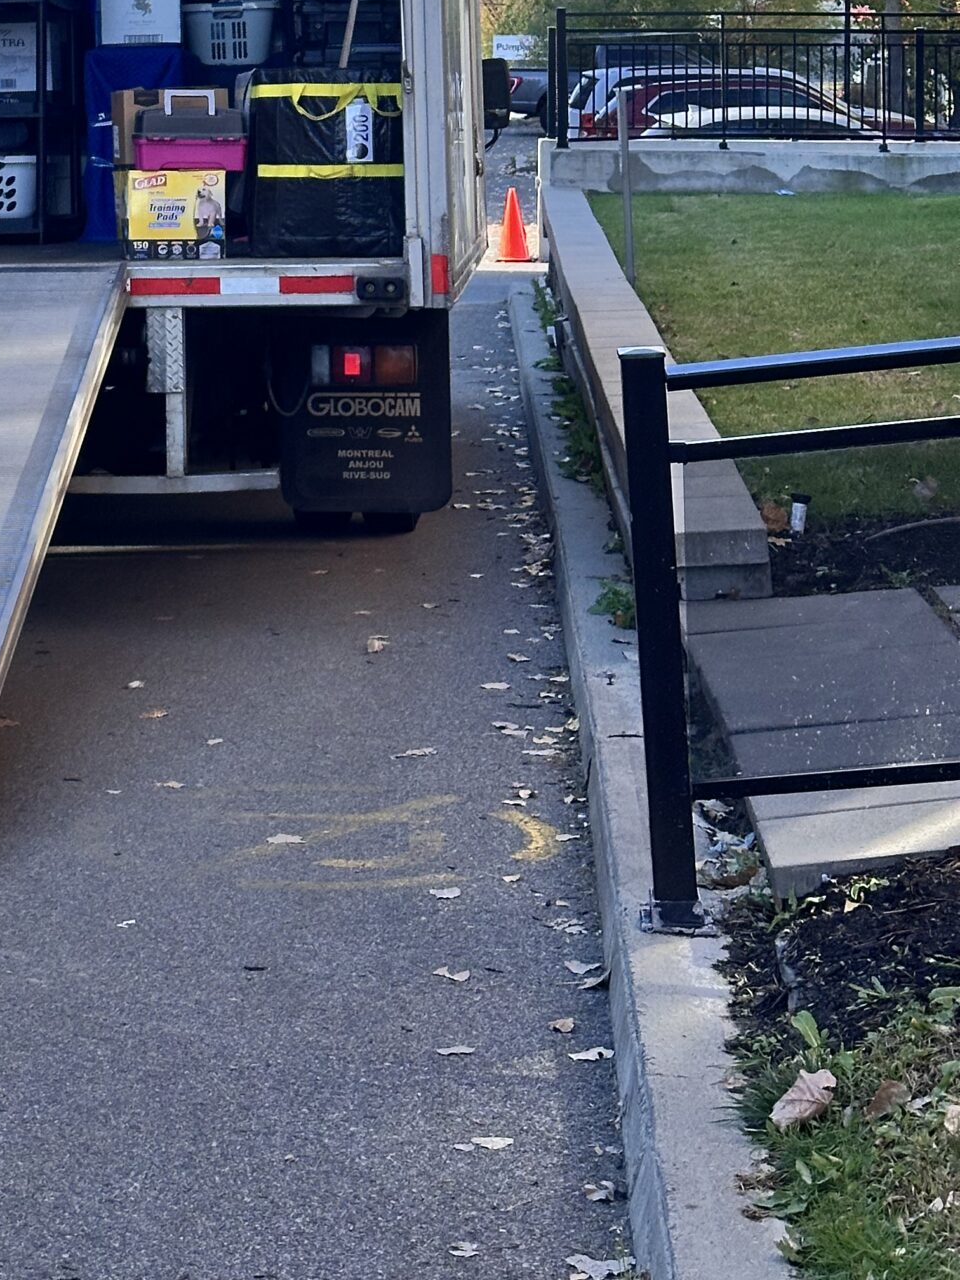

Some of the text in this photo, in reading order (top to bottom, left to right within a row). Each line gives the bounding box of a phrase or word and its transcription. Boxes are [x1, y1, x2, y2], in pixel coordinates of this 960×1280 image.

[352, 114, 369, 142] 200
[134, 176, 166, 189] GLAD
[149, 203, 186, 213] Training
[156, 213, 178, 221] Pads
[133, 241, 149, 249] 150
[306, 392, 421, 417] GLOBOCAM
[337, 449, 394, 458] MONTREAL
[348, 460, 384, 468] ANJOU
[342, 471, 391, 480] RIVE-SUD
